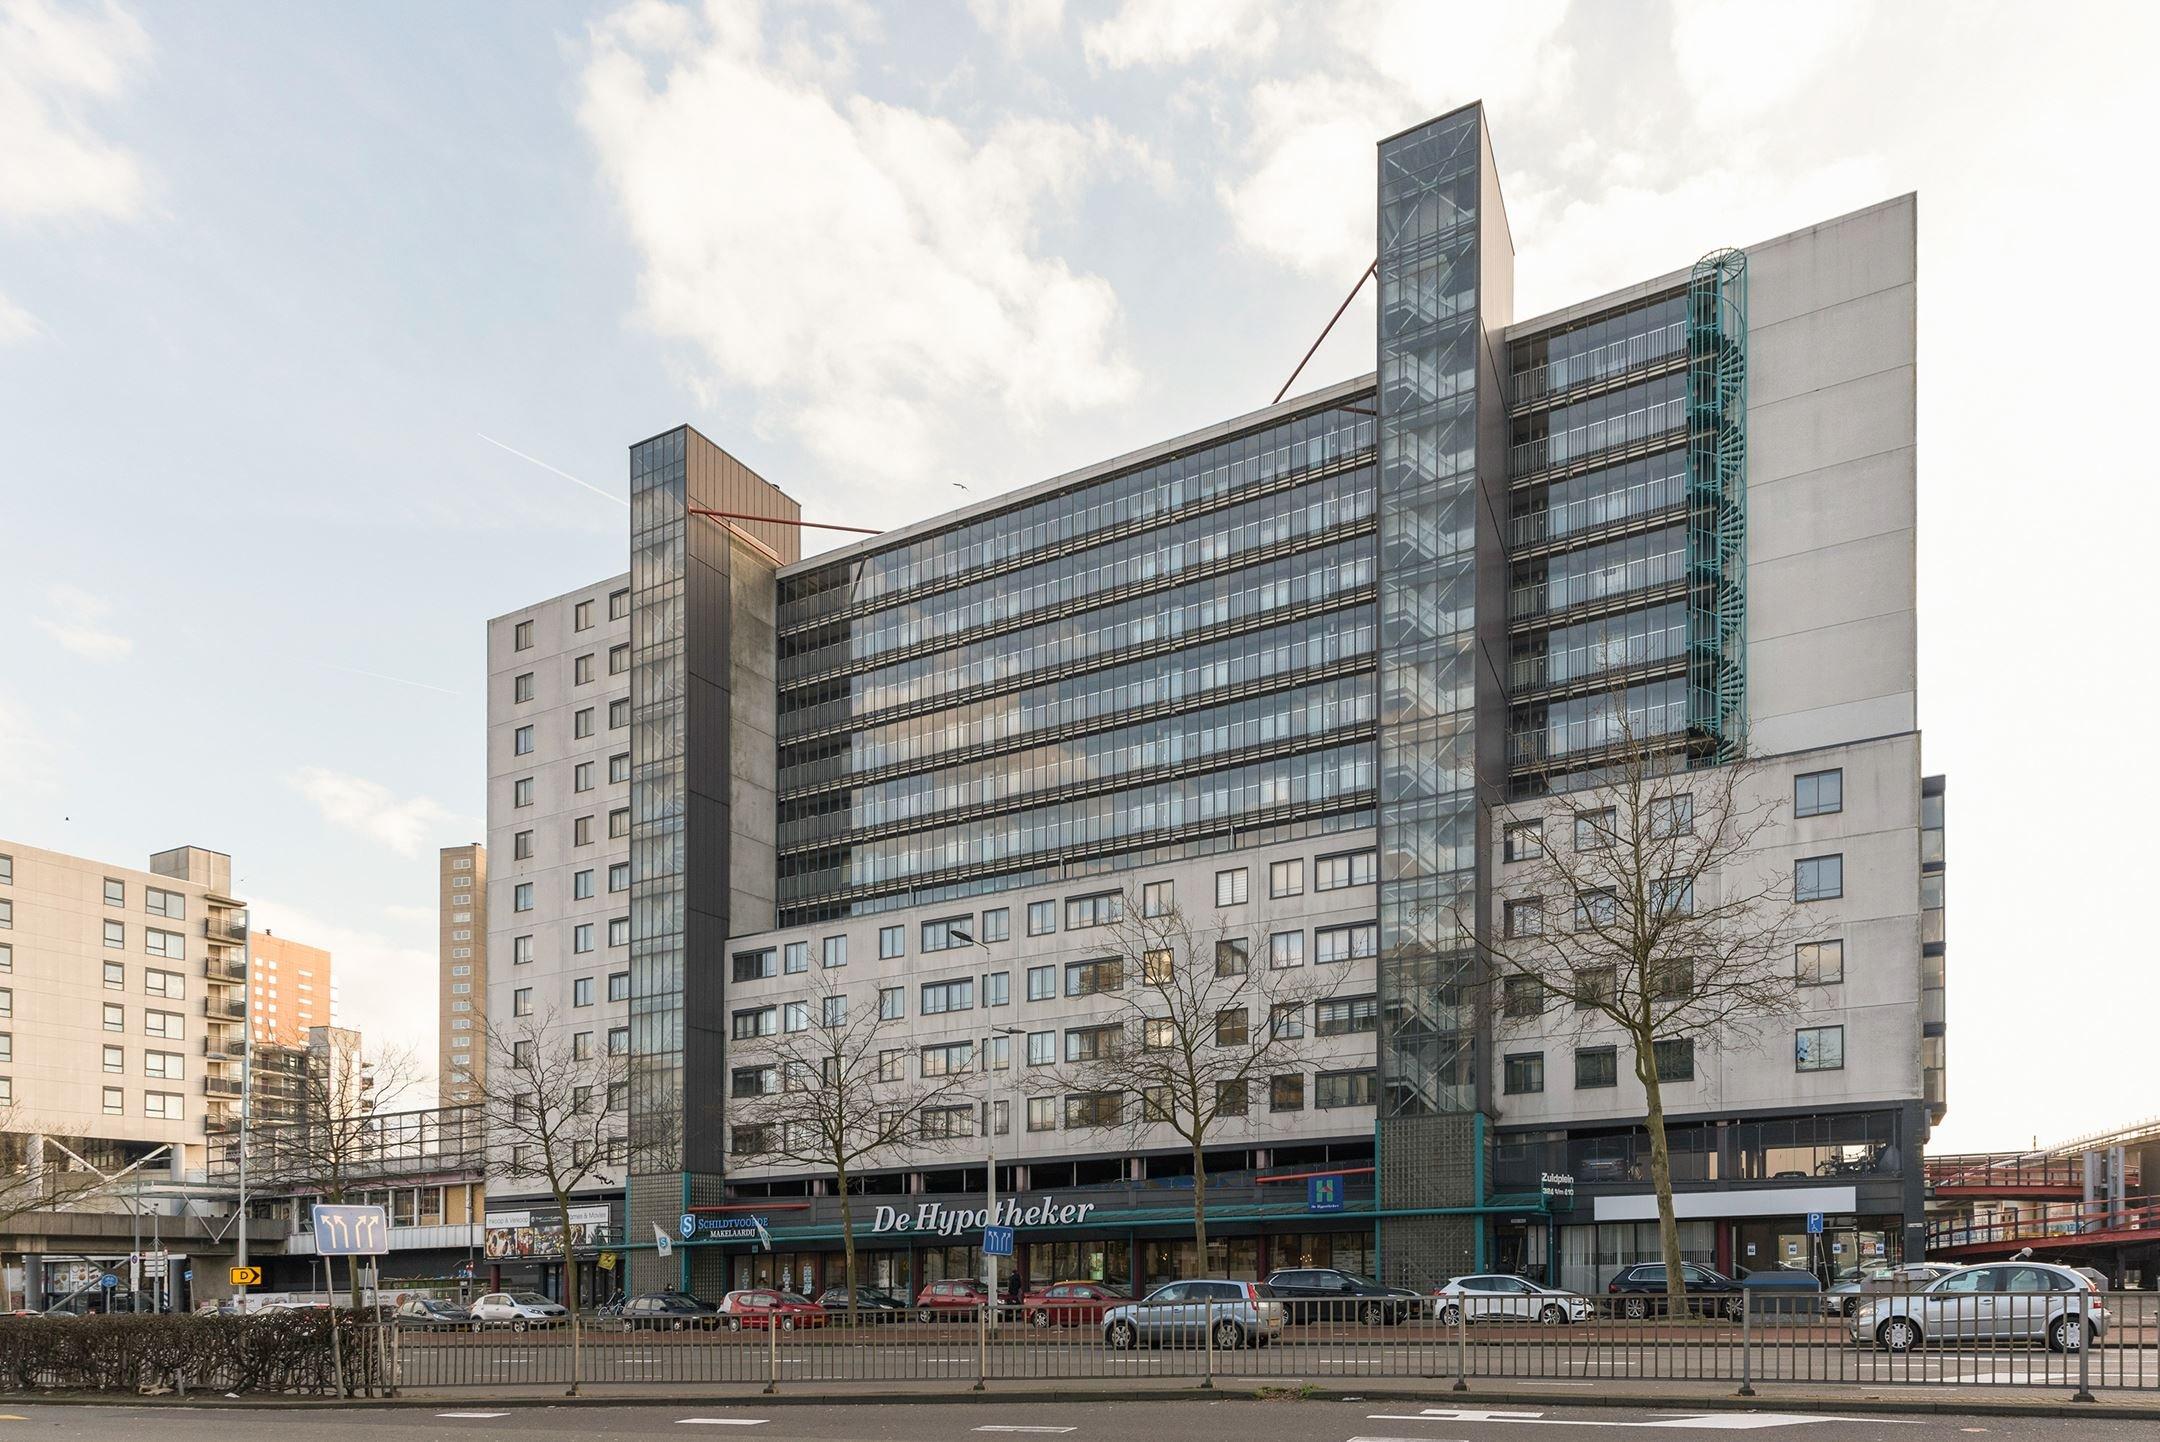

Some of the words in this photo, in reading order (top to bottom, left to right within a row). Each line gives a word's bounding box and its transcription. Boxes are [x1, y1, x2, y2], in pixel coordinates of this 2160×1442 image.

[1541, 1172, 1574, 1185] Zuidplein
[872, 1206, 910, 1232] De
[914, 1196, 1094, 1236] Hypotheker
[1811, 1214, 1819, 1224] P
[685, 1217, 692, 1232] S
[710, 1229, 755, 1238] MAKELAARDIJ
[240, 1271, 248, 1280] D
